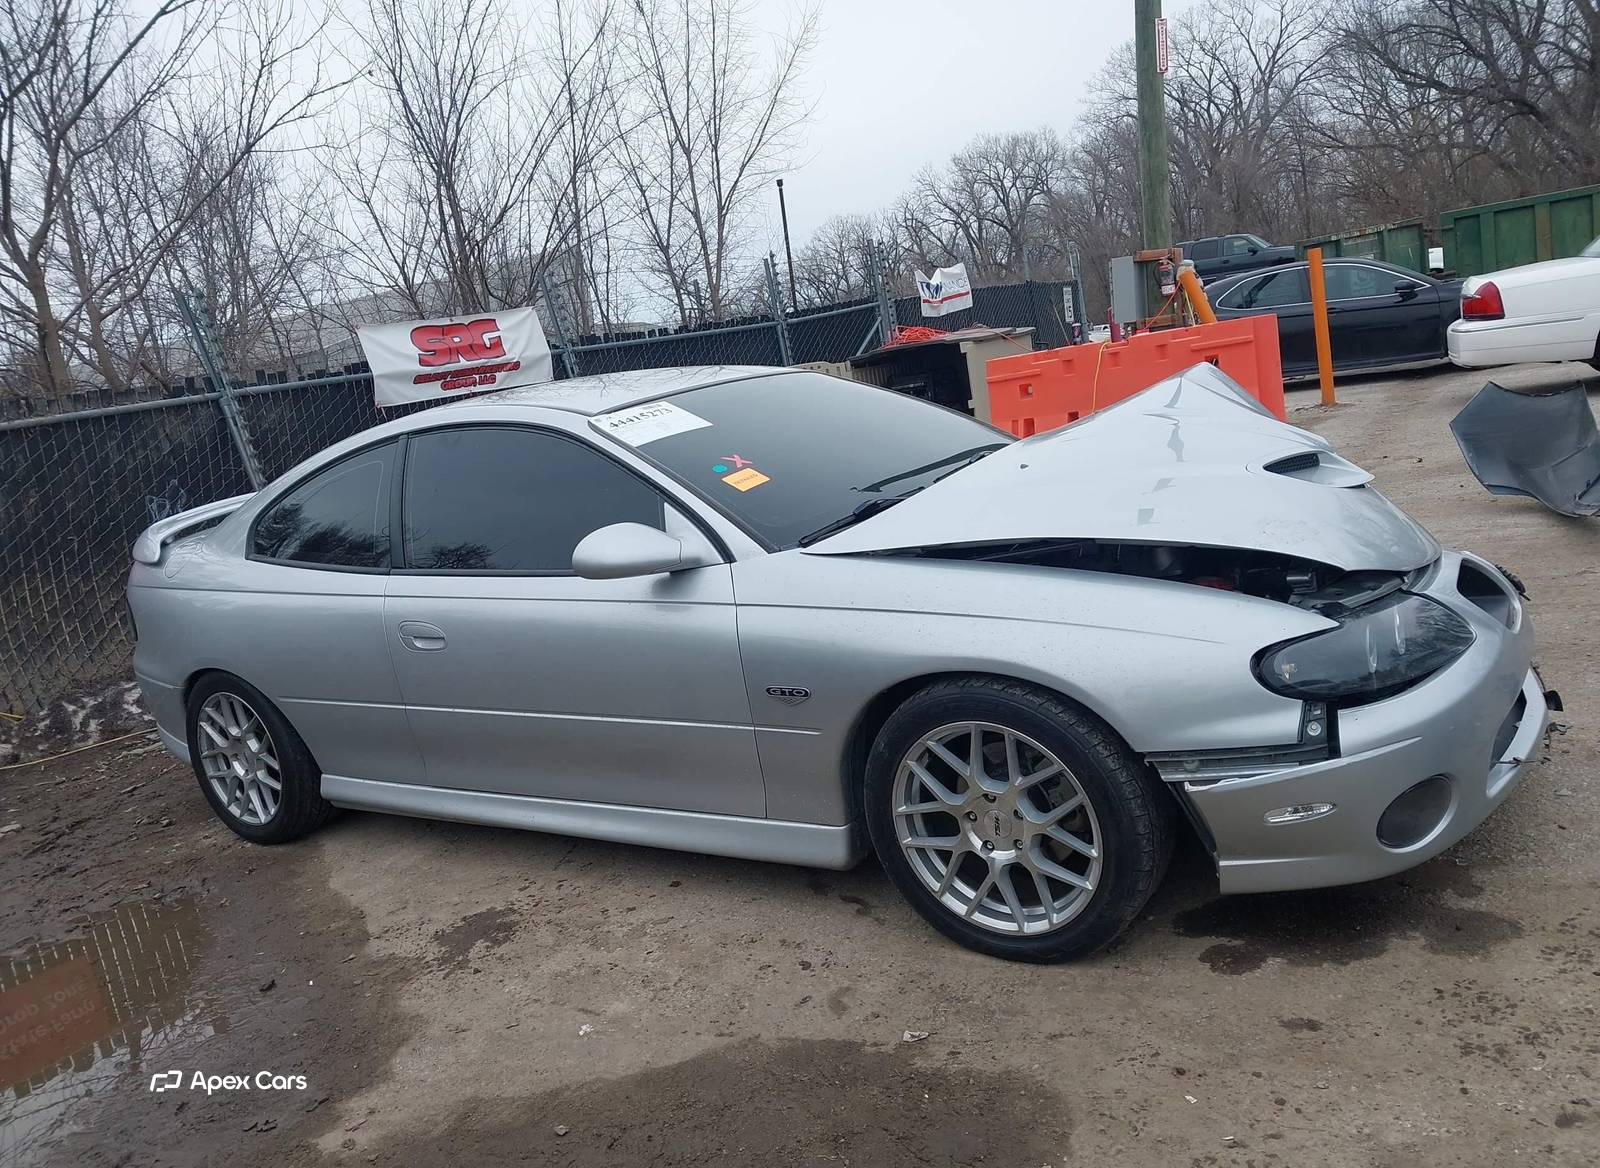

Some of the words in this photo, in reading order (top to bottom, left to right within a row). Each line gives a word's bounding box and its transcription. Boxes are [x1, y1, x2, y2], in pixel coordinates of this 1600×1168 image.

[410, 318, 507, 367] SRG
[413, 371, 452, 384] SELECT
[450, 361, 520, 378] REMARKETING
[478, 374, 496, 385] LLC
[770, 687, 806, 697] GTO
[993, 811, 1001, 837] TSW
